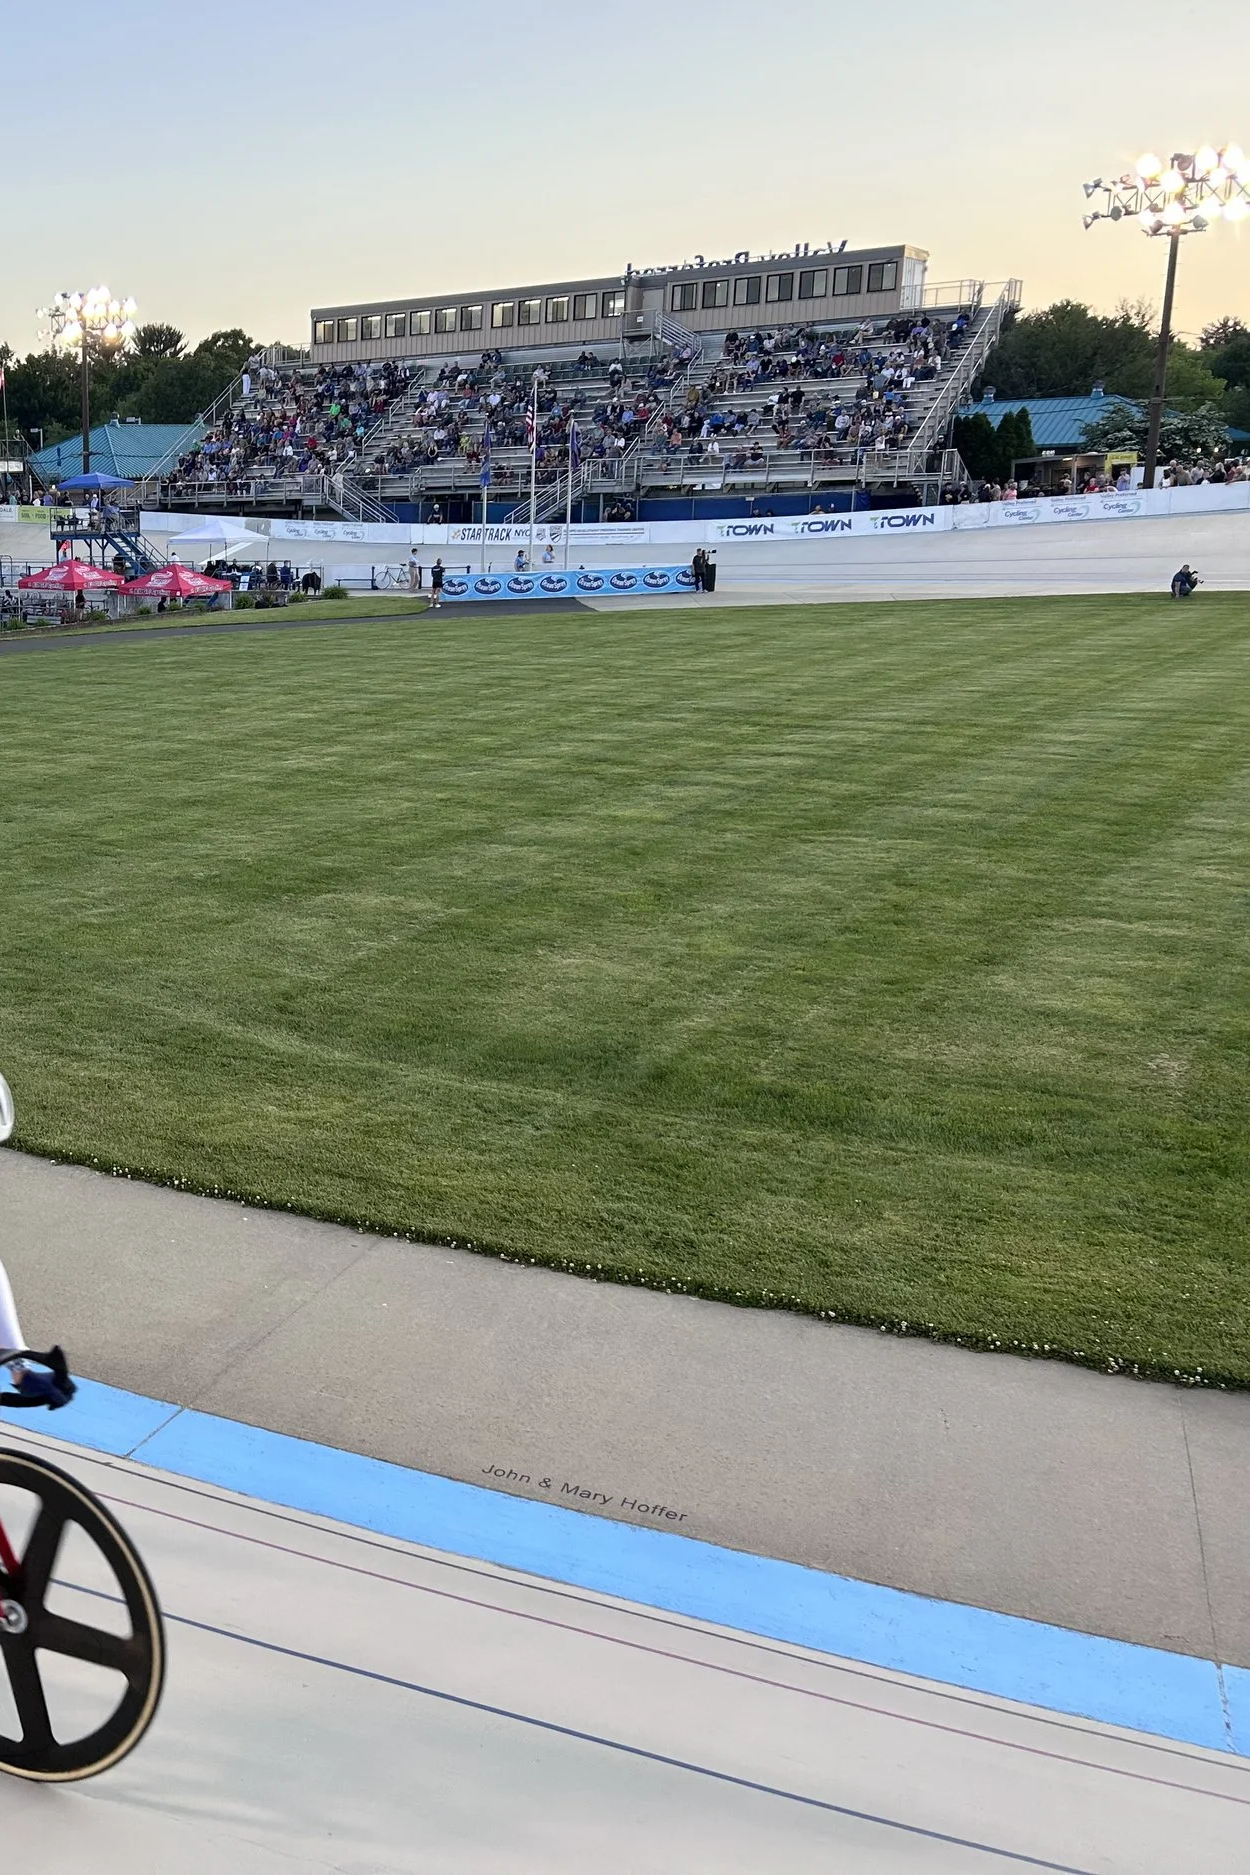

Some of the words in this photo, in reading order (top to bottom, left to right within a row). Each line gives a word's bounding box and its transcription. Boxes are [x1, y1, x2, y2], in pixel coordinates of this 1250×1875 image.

[461, 527, 482, 540] STAR
[484, 527, 512, 541] TRACK
[482, 1464, 531, 1484] John
[538, 1477, 552, 1489] &
[560, 1482, 614, 1505] Mary
[621, 1497, 688, 1522] Hoffer
